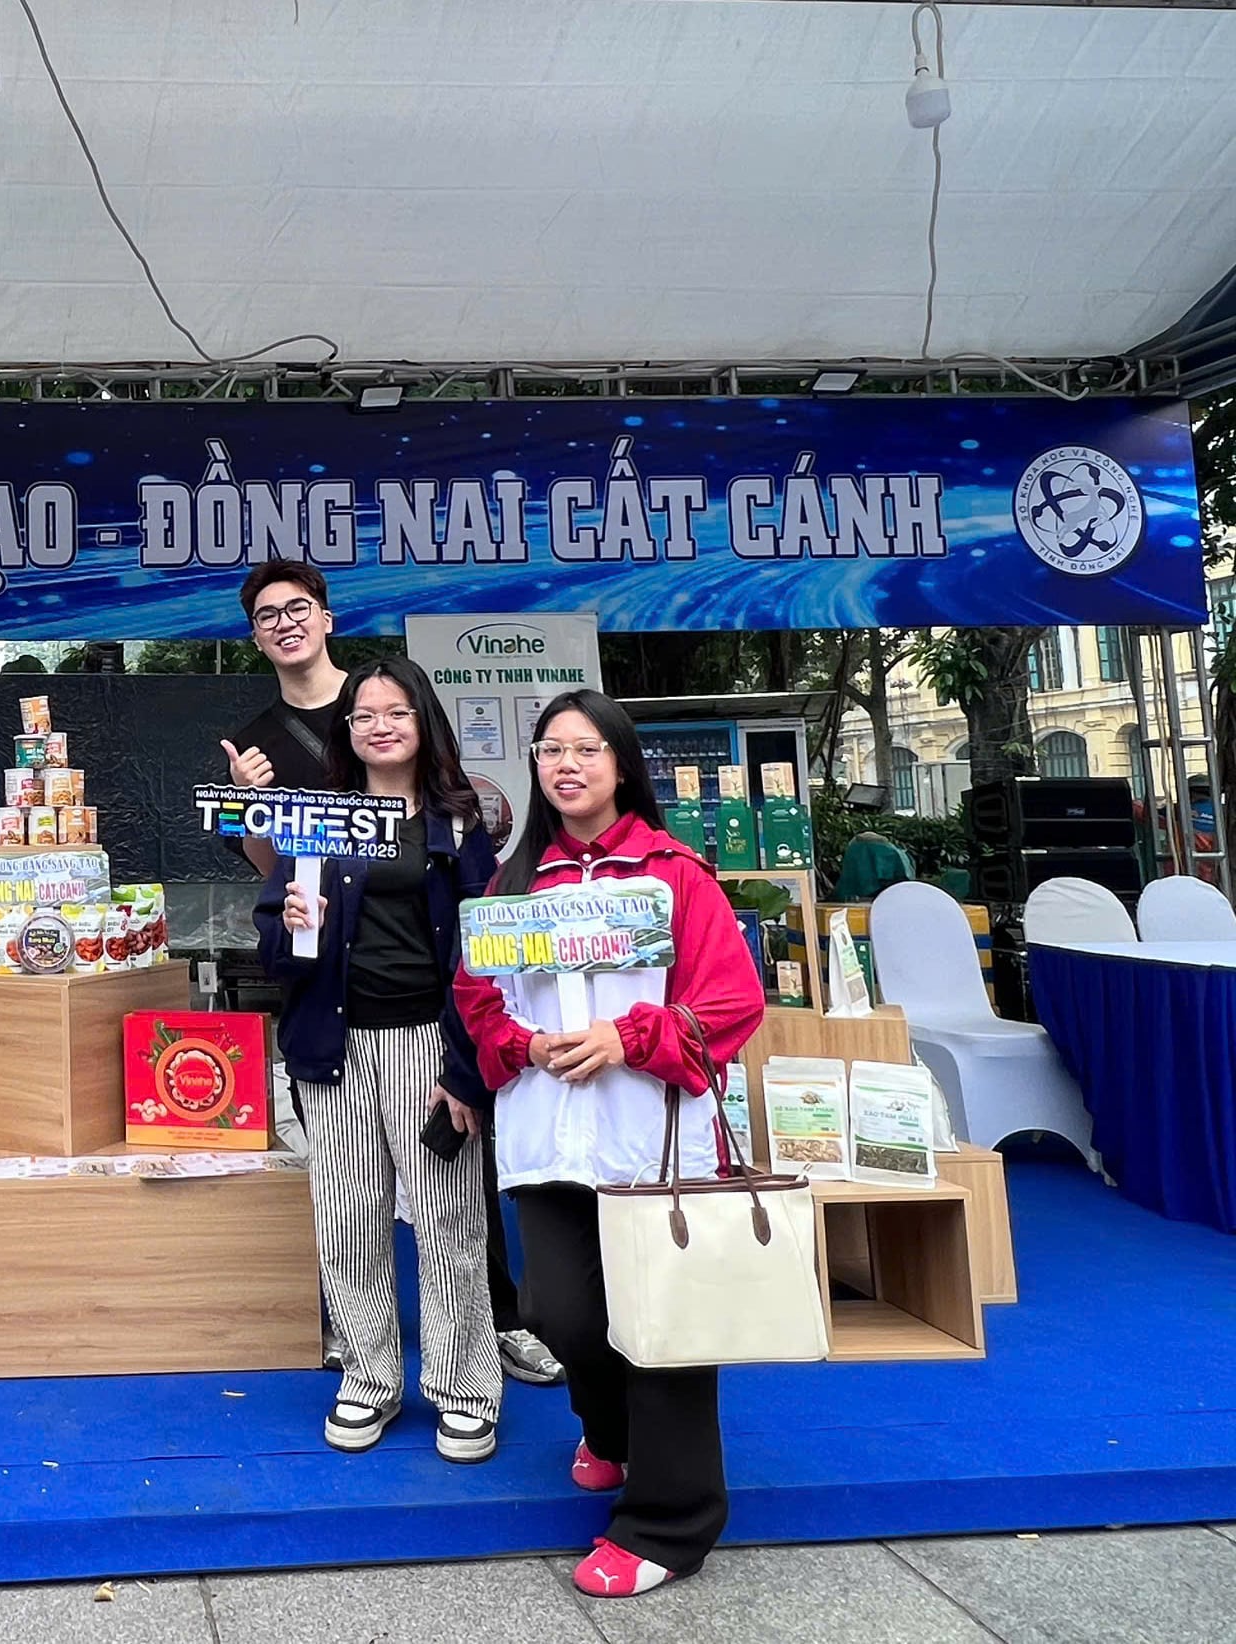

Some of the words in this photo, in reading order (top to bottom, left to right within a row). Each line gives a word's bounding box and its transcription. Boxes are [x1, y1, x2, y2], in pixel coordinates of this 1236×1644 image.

[139, 439, 356, 567] ĐỒNG
[378, 478, 527, 566] NAI
[549, 434, 706, 562] CẤT
[726, 451, 947, 562] CÁNH
[467, 634, 546, 654] Vinahe
[434, 667, 472, 684] CÔNG
[475, 669, 492, 684] TY
[496, 669, 533, 683] TNHH
[536, 668, 585, 683] VINAHE
[196, 789, 220, 799] NGÀY
[220, 791, 236, 801] HỘI
[261, 791, 289, 803] NGHIỆP
[291, 792, 315, 804] SÁNG
[317, 795, 335, 807] TẠO
[335, 795, 362, 807] QUỐC
[363, 799, 379, 807] GIA
[380, 799, 403, 809] 2025
[195, 800, 404, 841] TECHFEST
[276, 837, 352, 855] VIETNAM
[357, 842, 397, 858] 2025
[521, 932, 554, 964] NAI
